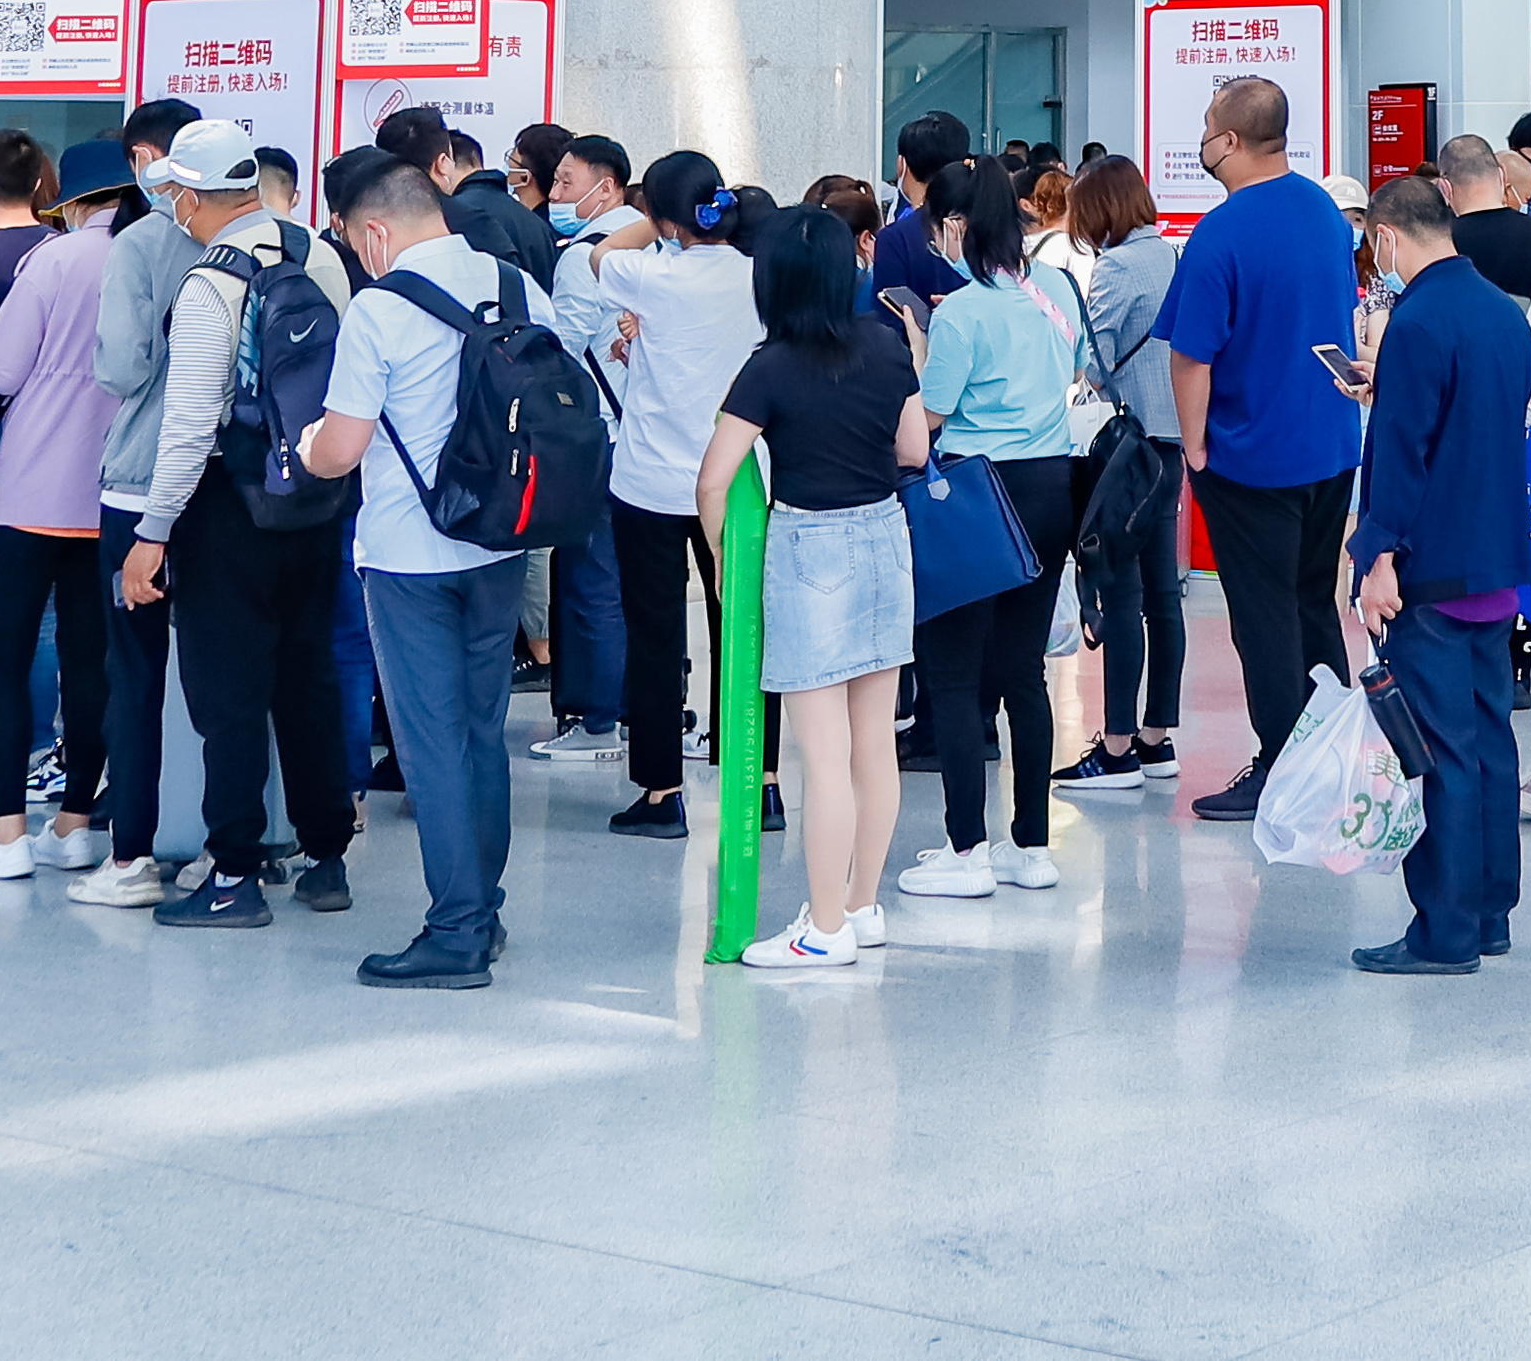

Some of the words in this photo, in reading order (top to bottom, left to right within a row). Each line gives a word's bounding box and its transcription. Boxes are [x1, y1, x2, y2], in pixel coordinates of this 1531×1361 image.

[412, 0, 473, 14] 扫描二维码
[56, 18, 116, 31] 扫描二维码
[1192, 18, 1280, 43] 扫描二维码
[184, 39, 273, 69] 扫描二维码
[489, 35, 522, 58] 有责
[1371, 109, 1384, 121] 2F
